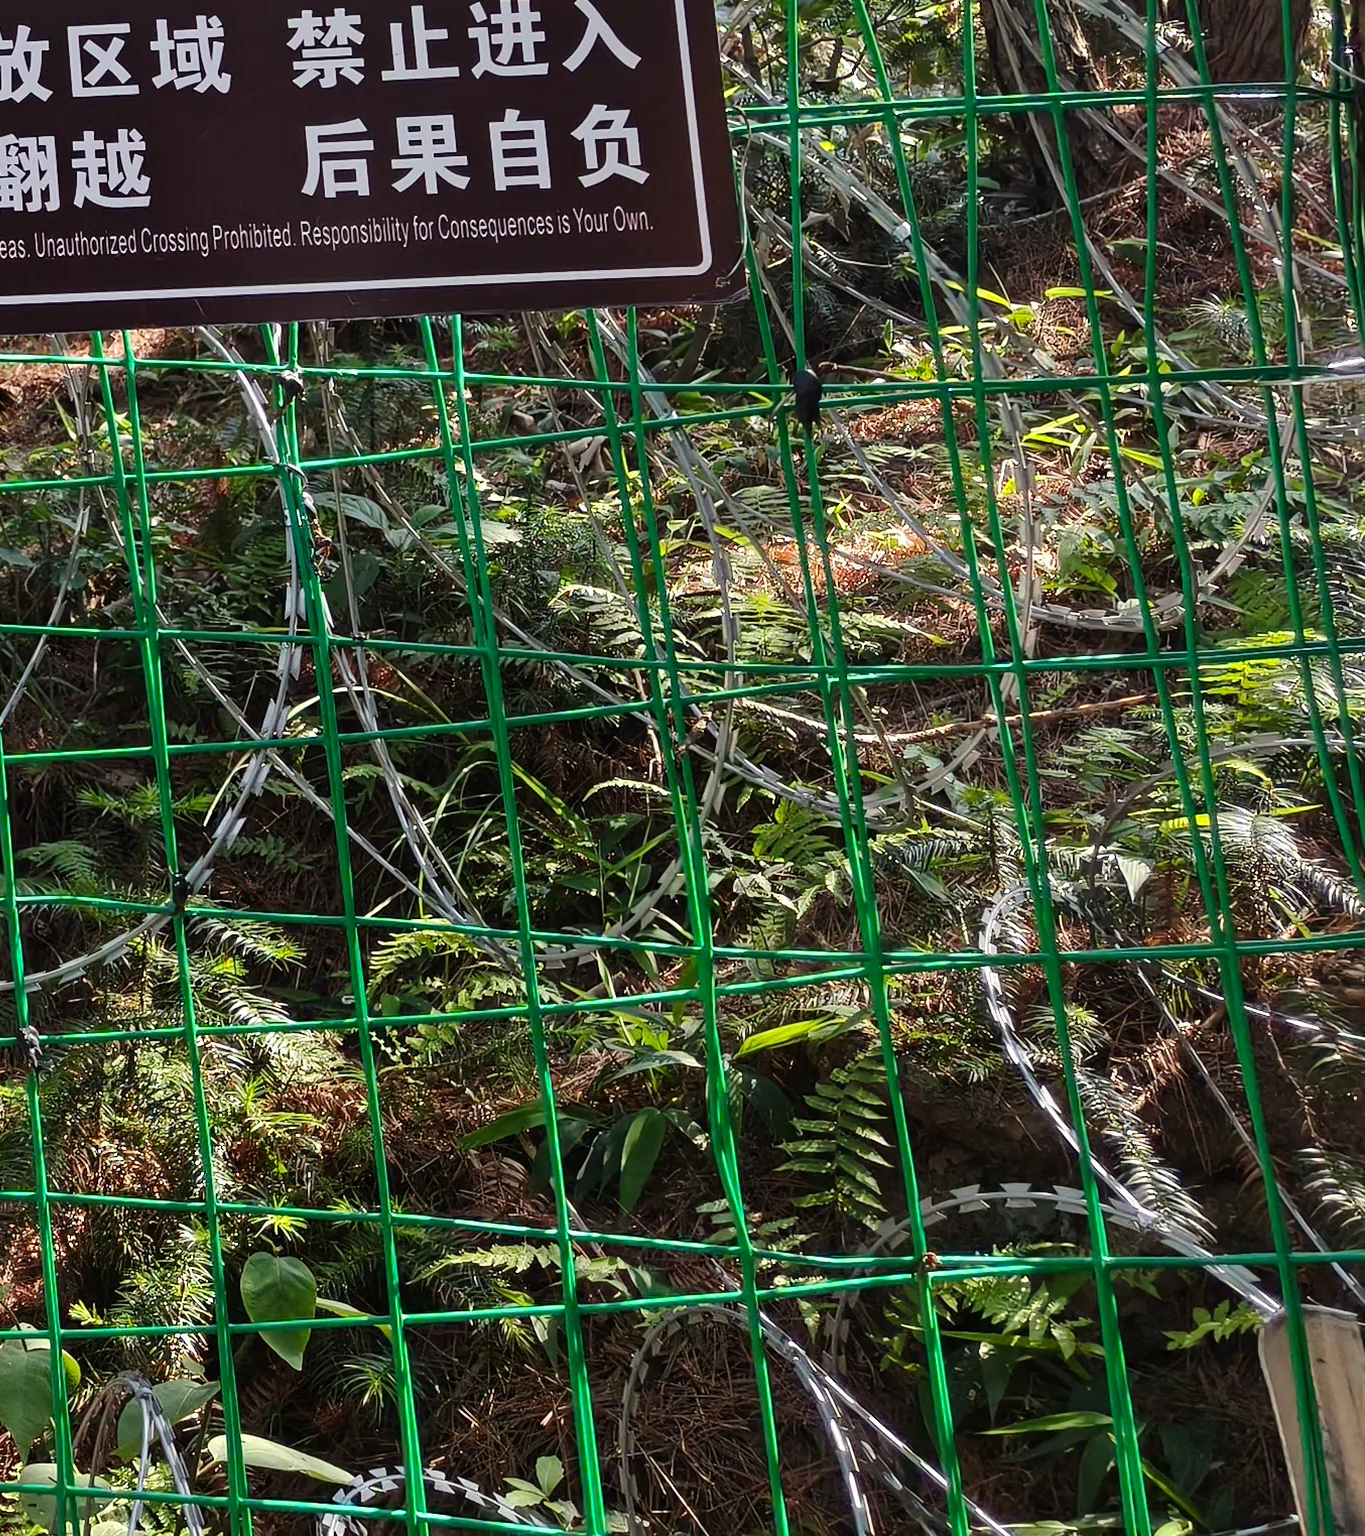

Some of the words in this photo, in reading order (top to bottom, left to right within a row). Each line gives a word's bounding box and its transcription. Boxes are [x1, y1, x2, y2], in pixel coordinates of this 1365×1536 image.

[300, 103, 650, 198] 后果自负
[34, 228, 137, 258] Unauthorized
[140, 227, 210, 258] Crossing
[212, 221, 297, 250] Prohibited.
[300, 216, 409, 252] Responsibility
[412, 215, 434, 241] for
[437, 213, 556, 244] Consequences
[557, 208, 571, 234] is
[572, 207, 609, 234] Your
[612, 205, 654, 232] Own.
